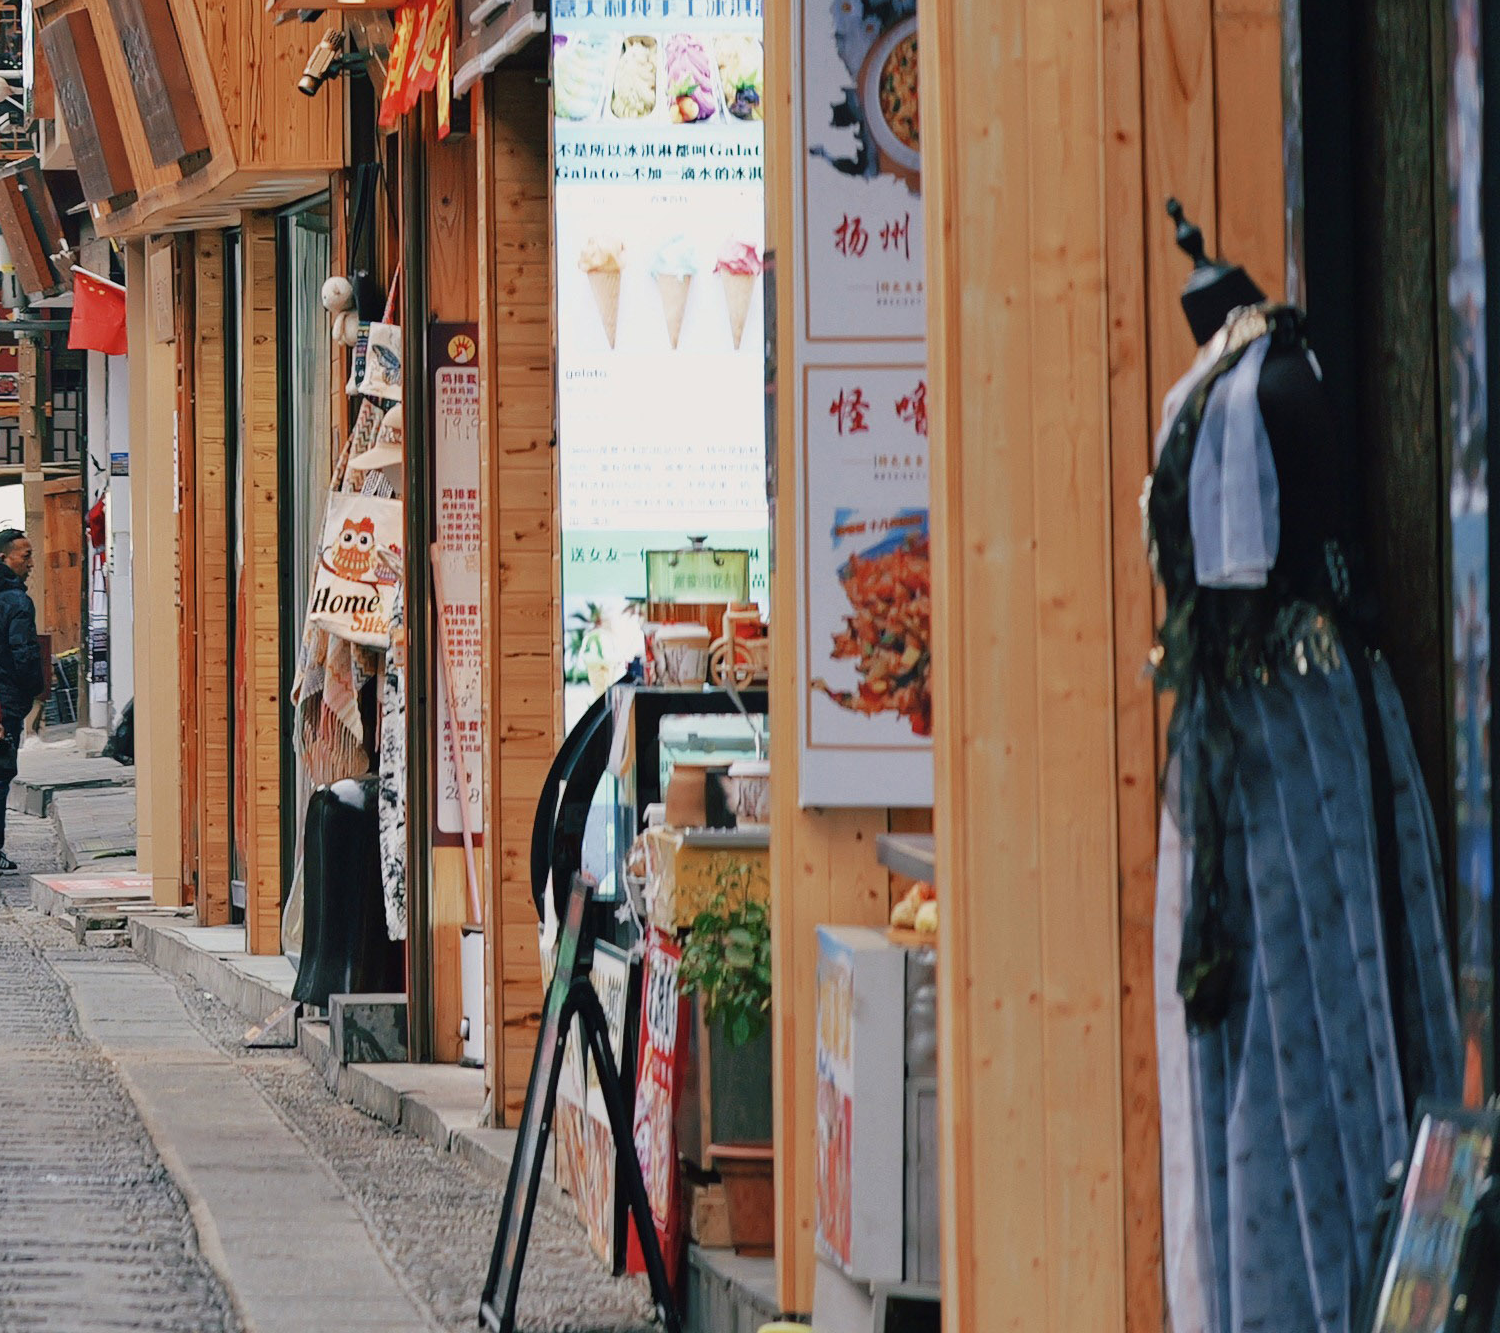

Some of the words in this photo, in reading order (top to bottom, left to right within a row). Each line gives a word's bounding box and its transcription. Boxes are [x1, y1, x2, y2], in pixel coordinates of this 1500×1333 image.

[834, 212, 910, 261] 扬州
[311, 585, 381, 614] Home
[350, 610, 391, 635] Swee
